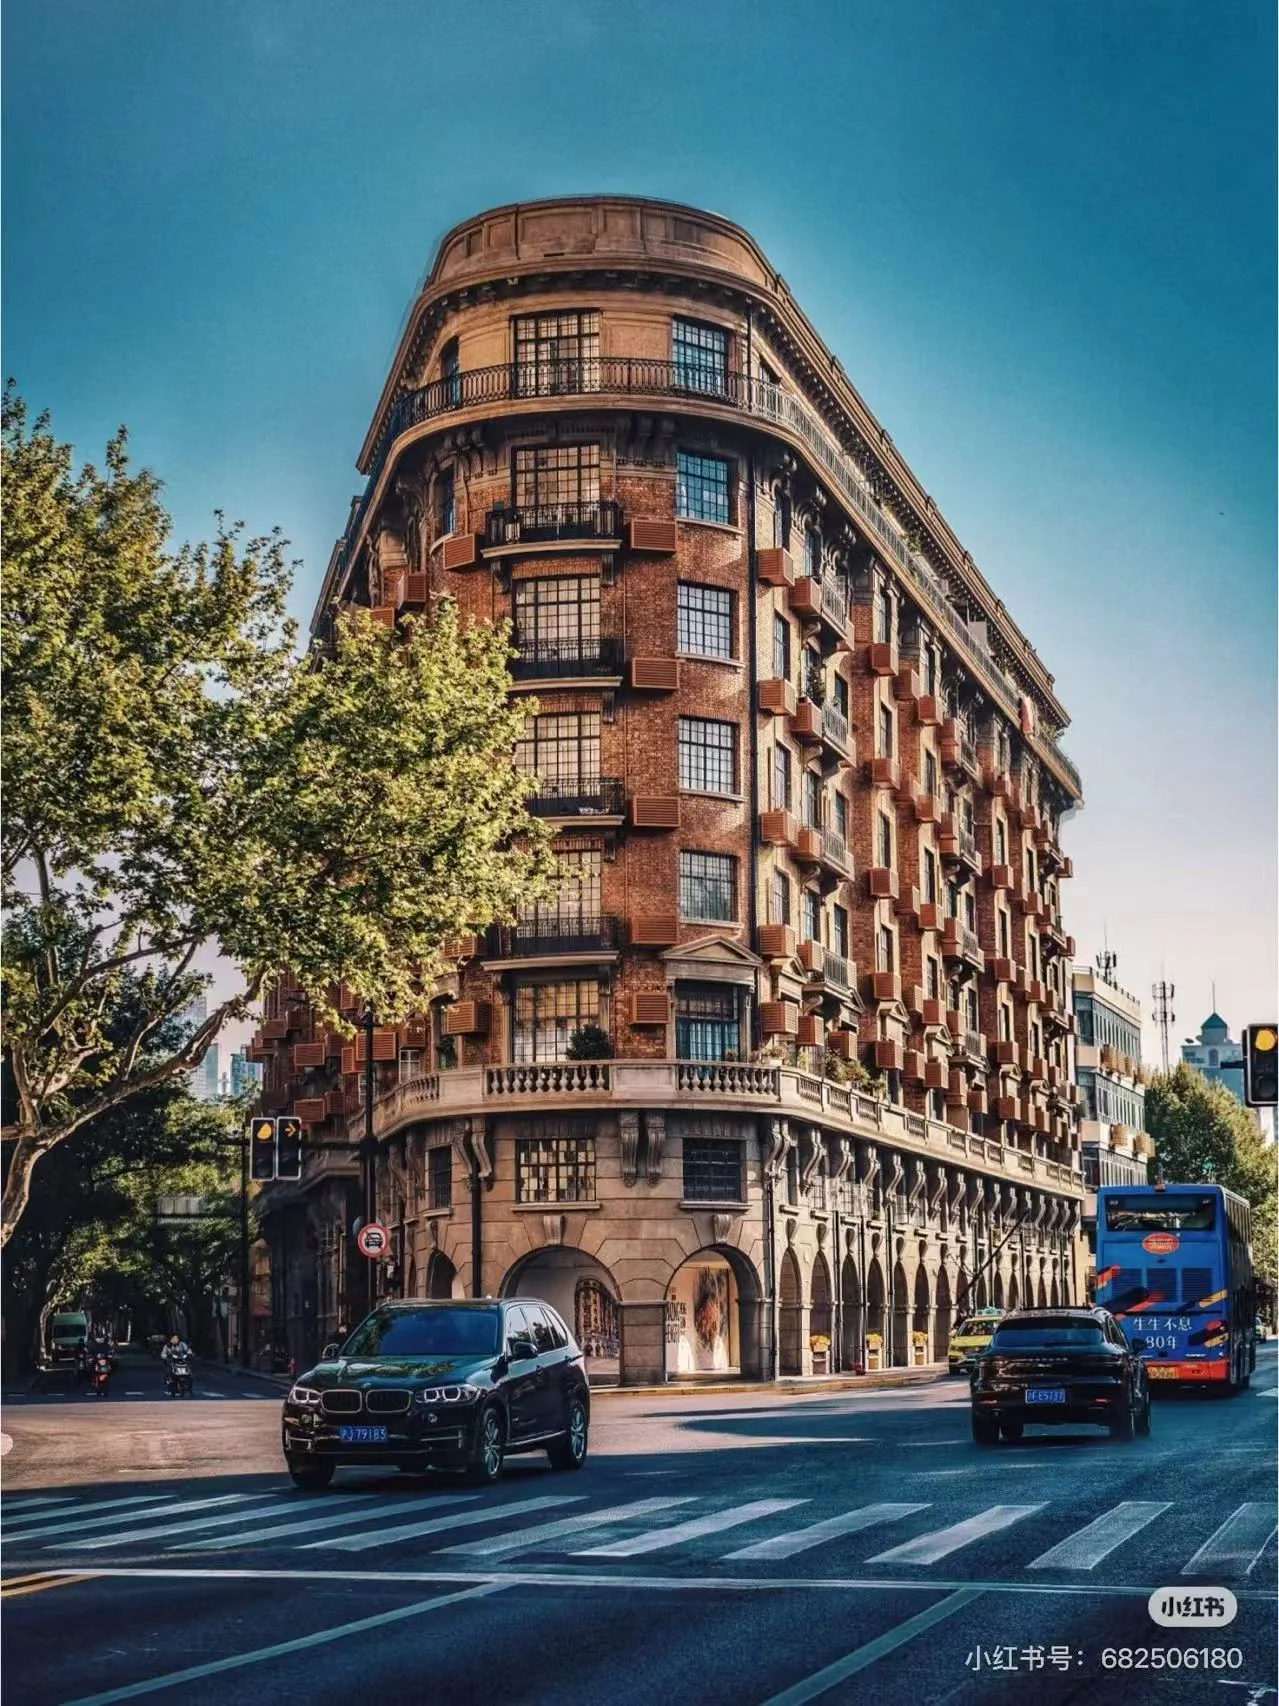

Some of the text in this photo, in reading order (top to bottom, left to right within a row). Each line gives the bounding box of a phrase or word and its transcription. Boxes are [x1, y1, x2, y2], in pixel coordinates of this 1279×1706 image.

[1133, 1316, 1192, 1331] 生生不息
[1145, 1335, 1177, 1350] 80年
